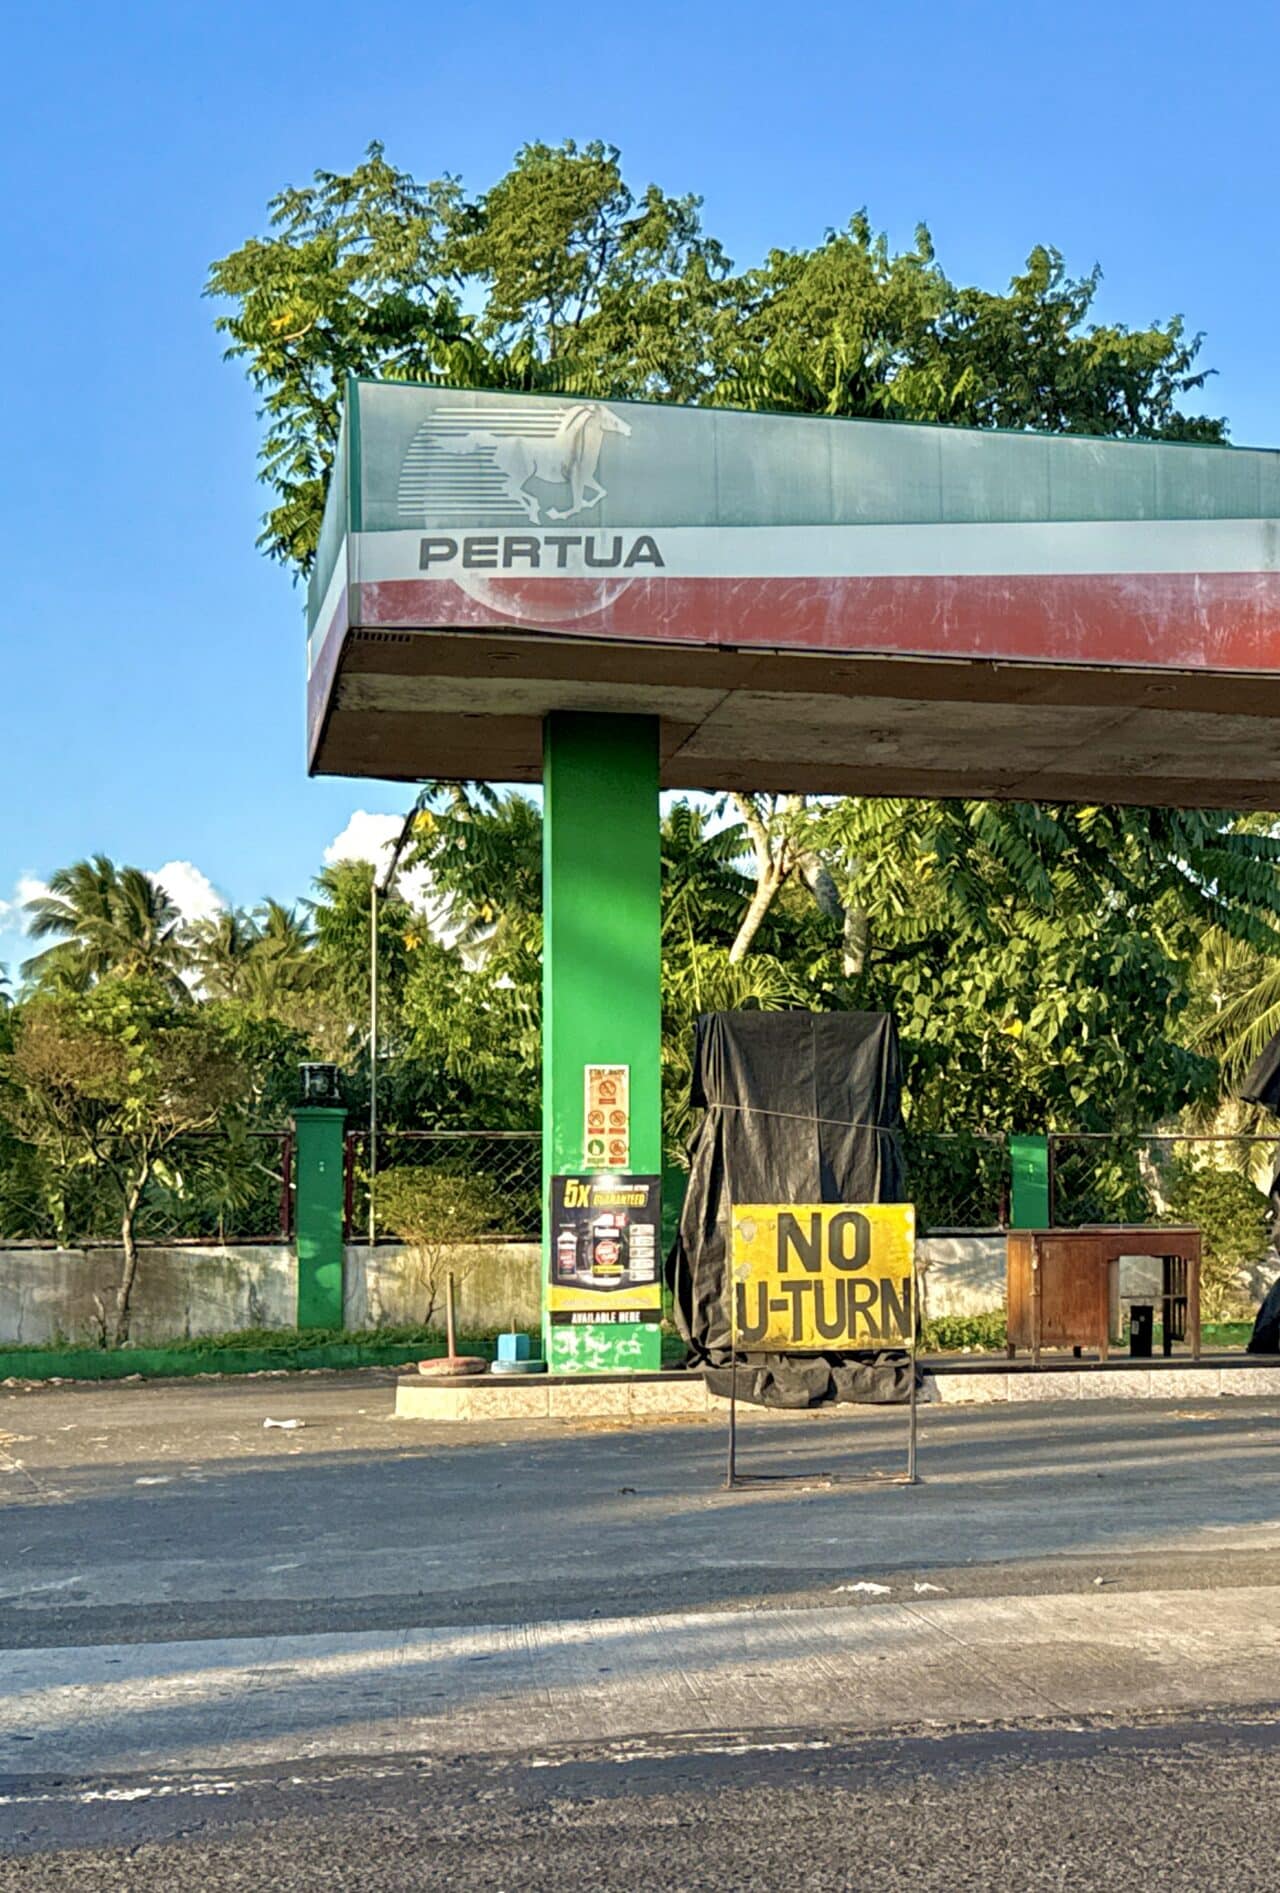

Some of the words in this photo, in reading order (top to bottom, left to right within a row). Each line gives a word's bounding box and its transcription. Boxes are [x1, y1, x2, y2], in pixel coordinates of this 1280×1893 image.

[418, 535, 666, 570] PERTUA
[777, 1211, 871, 1273] NO
[571, 1311, 617, 1324] AVAILABLE
[618, 1310, 641, 1324] HERE
[735, 1276, 912, 1342] U-TURN
